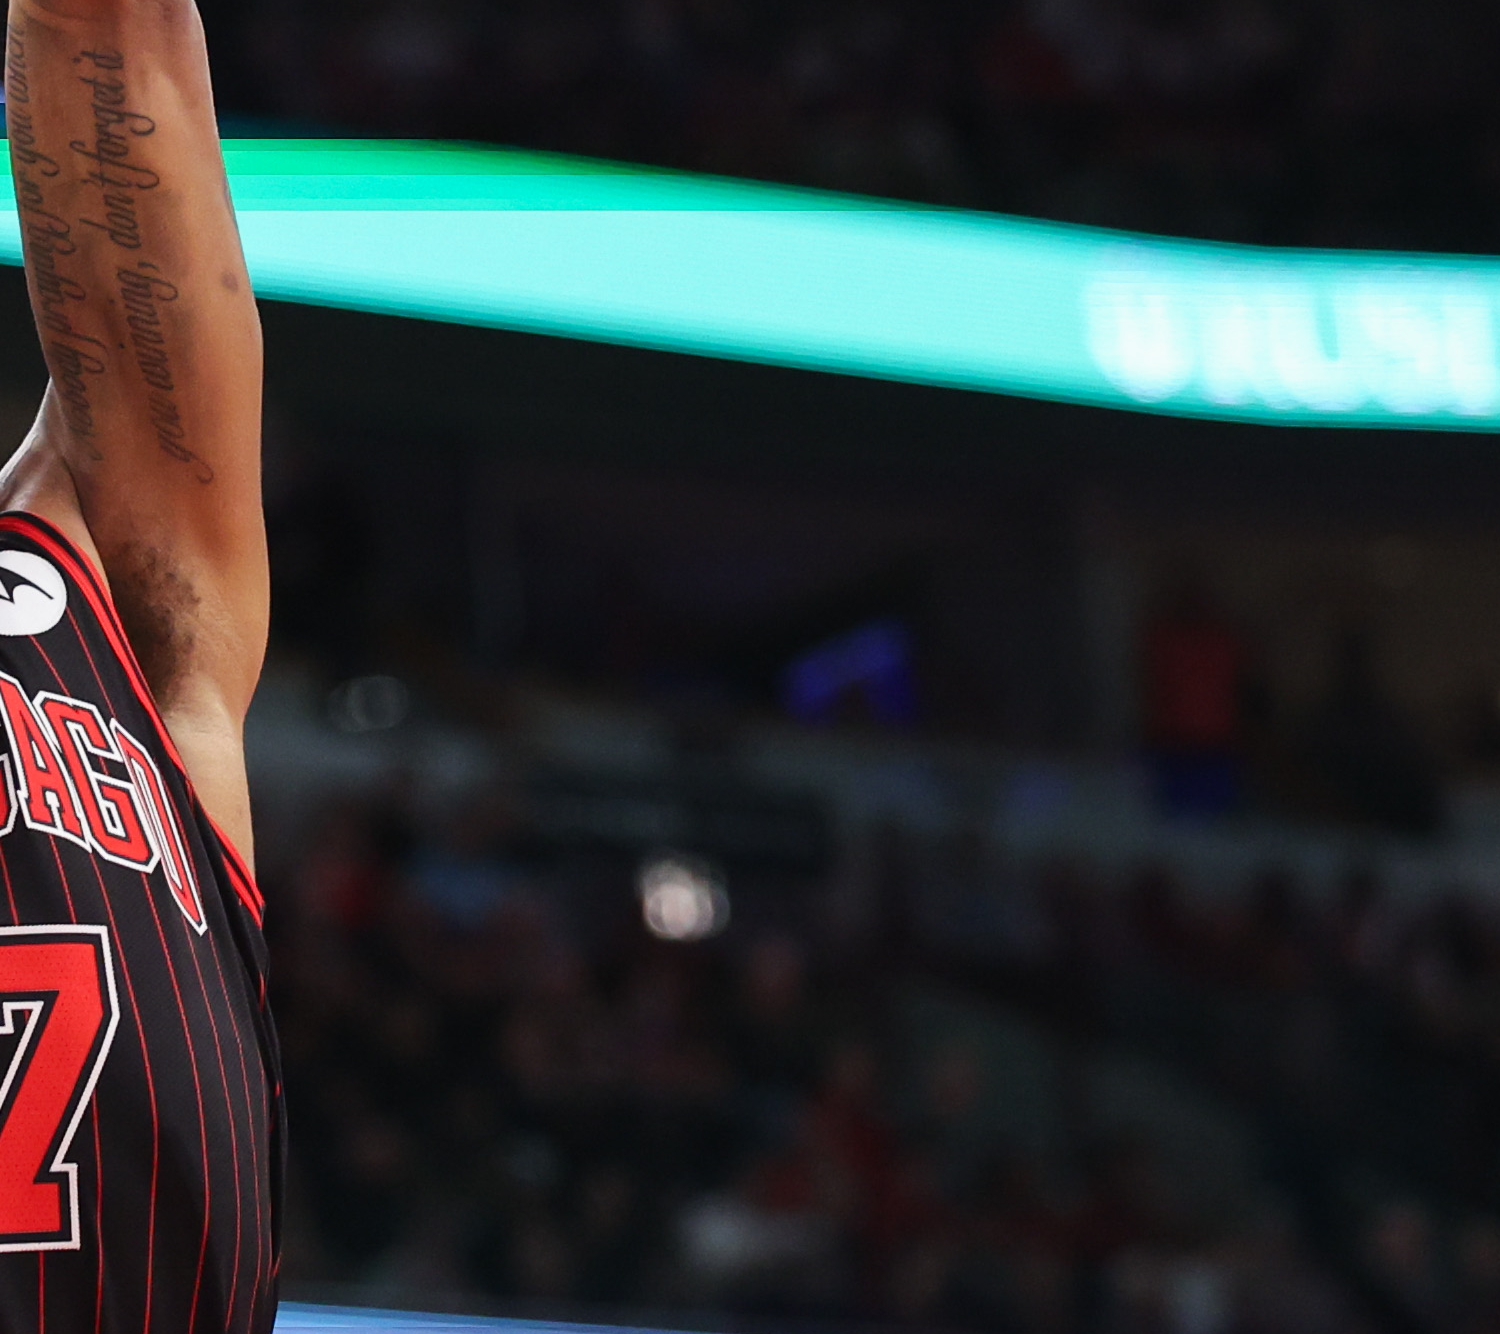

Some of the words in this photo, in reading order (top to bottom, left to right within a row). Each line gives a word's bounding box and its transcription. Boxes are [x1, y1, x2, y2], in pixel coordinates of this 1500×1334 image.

[71, 47, 125, 69] it
[12, 111, 61, 178] you
[70, 75, 160, 191] forget
[78, 169, 143, 250] don't
[148, 387, 214, 484] you
